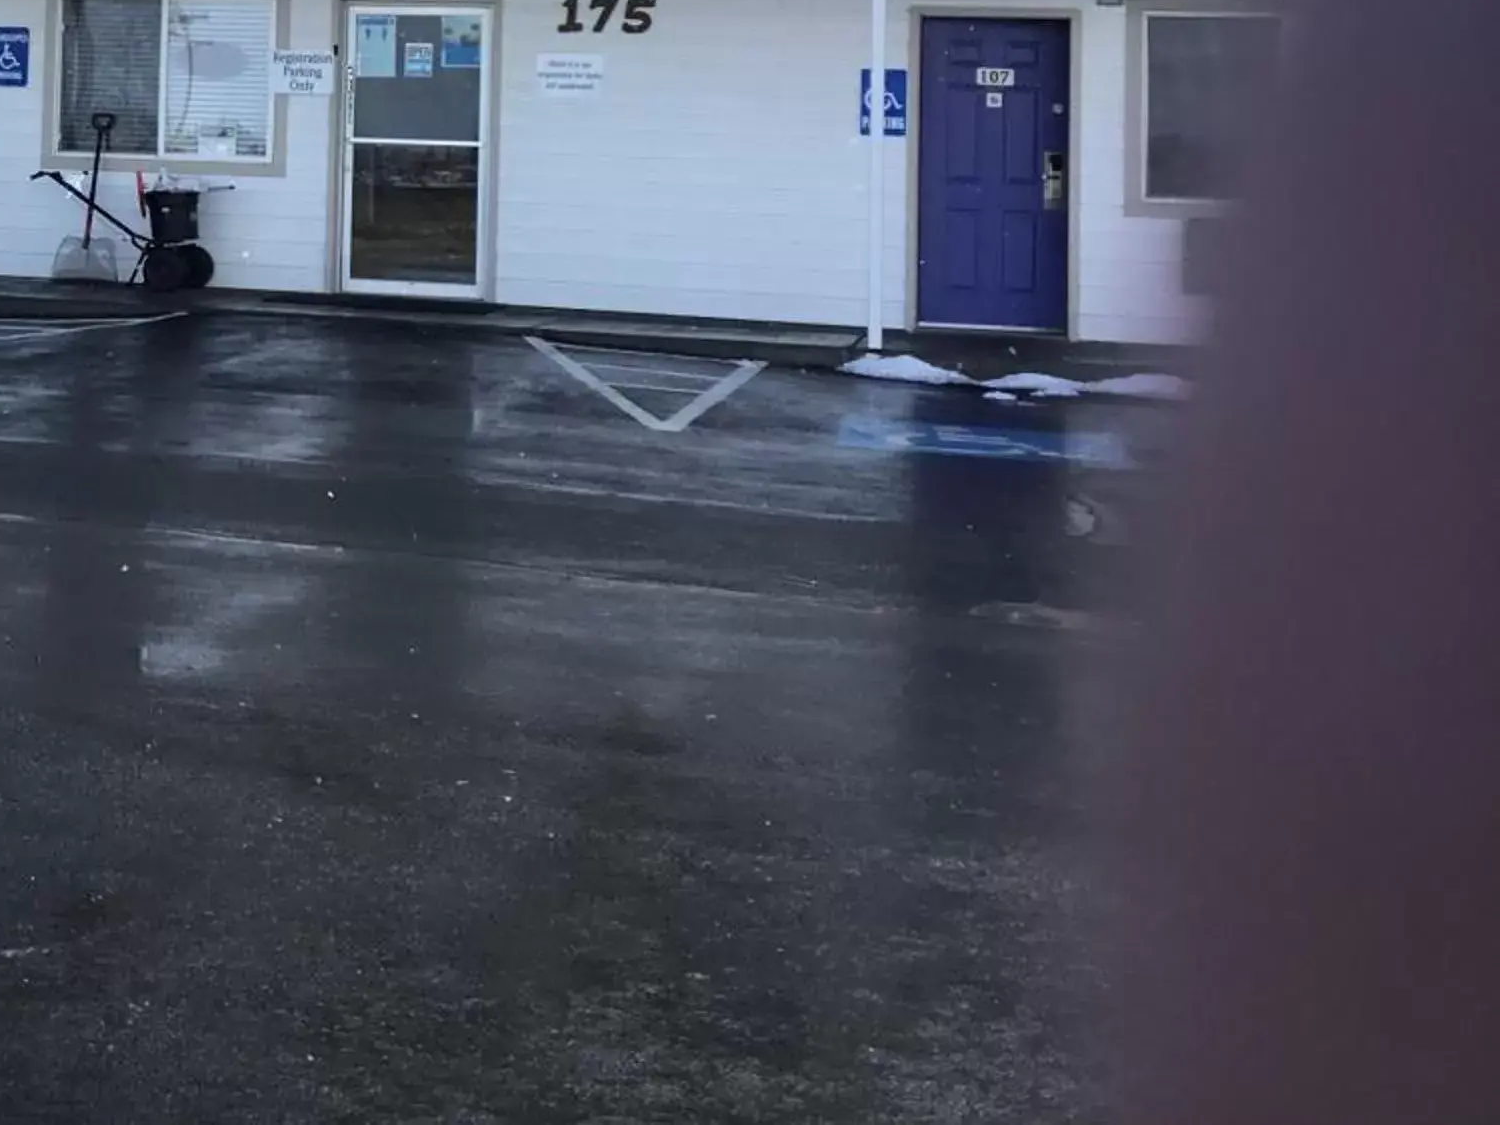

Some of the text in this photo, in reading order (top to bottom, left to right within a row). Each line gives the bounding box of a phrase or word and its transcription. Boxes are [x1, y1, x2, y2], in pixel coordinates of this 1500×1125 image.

[274, 52, 333, 66] Registration
[283, 65, 323, 80] Parking
[981, 70, 1010, 84] 107
[289, 78, 316, 93] Only
[861, 116, 905, 130] PING
